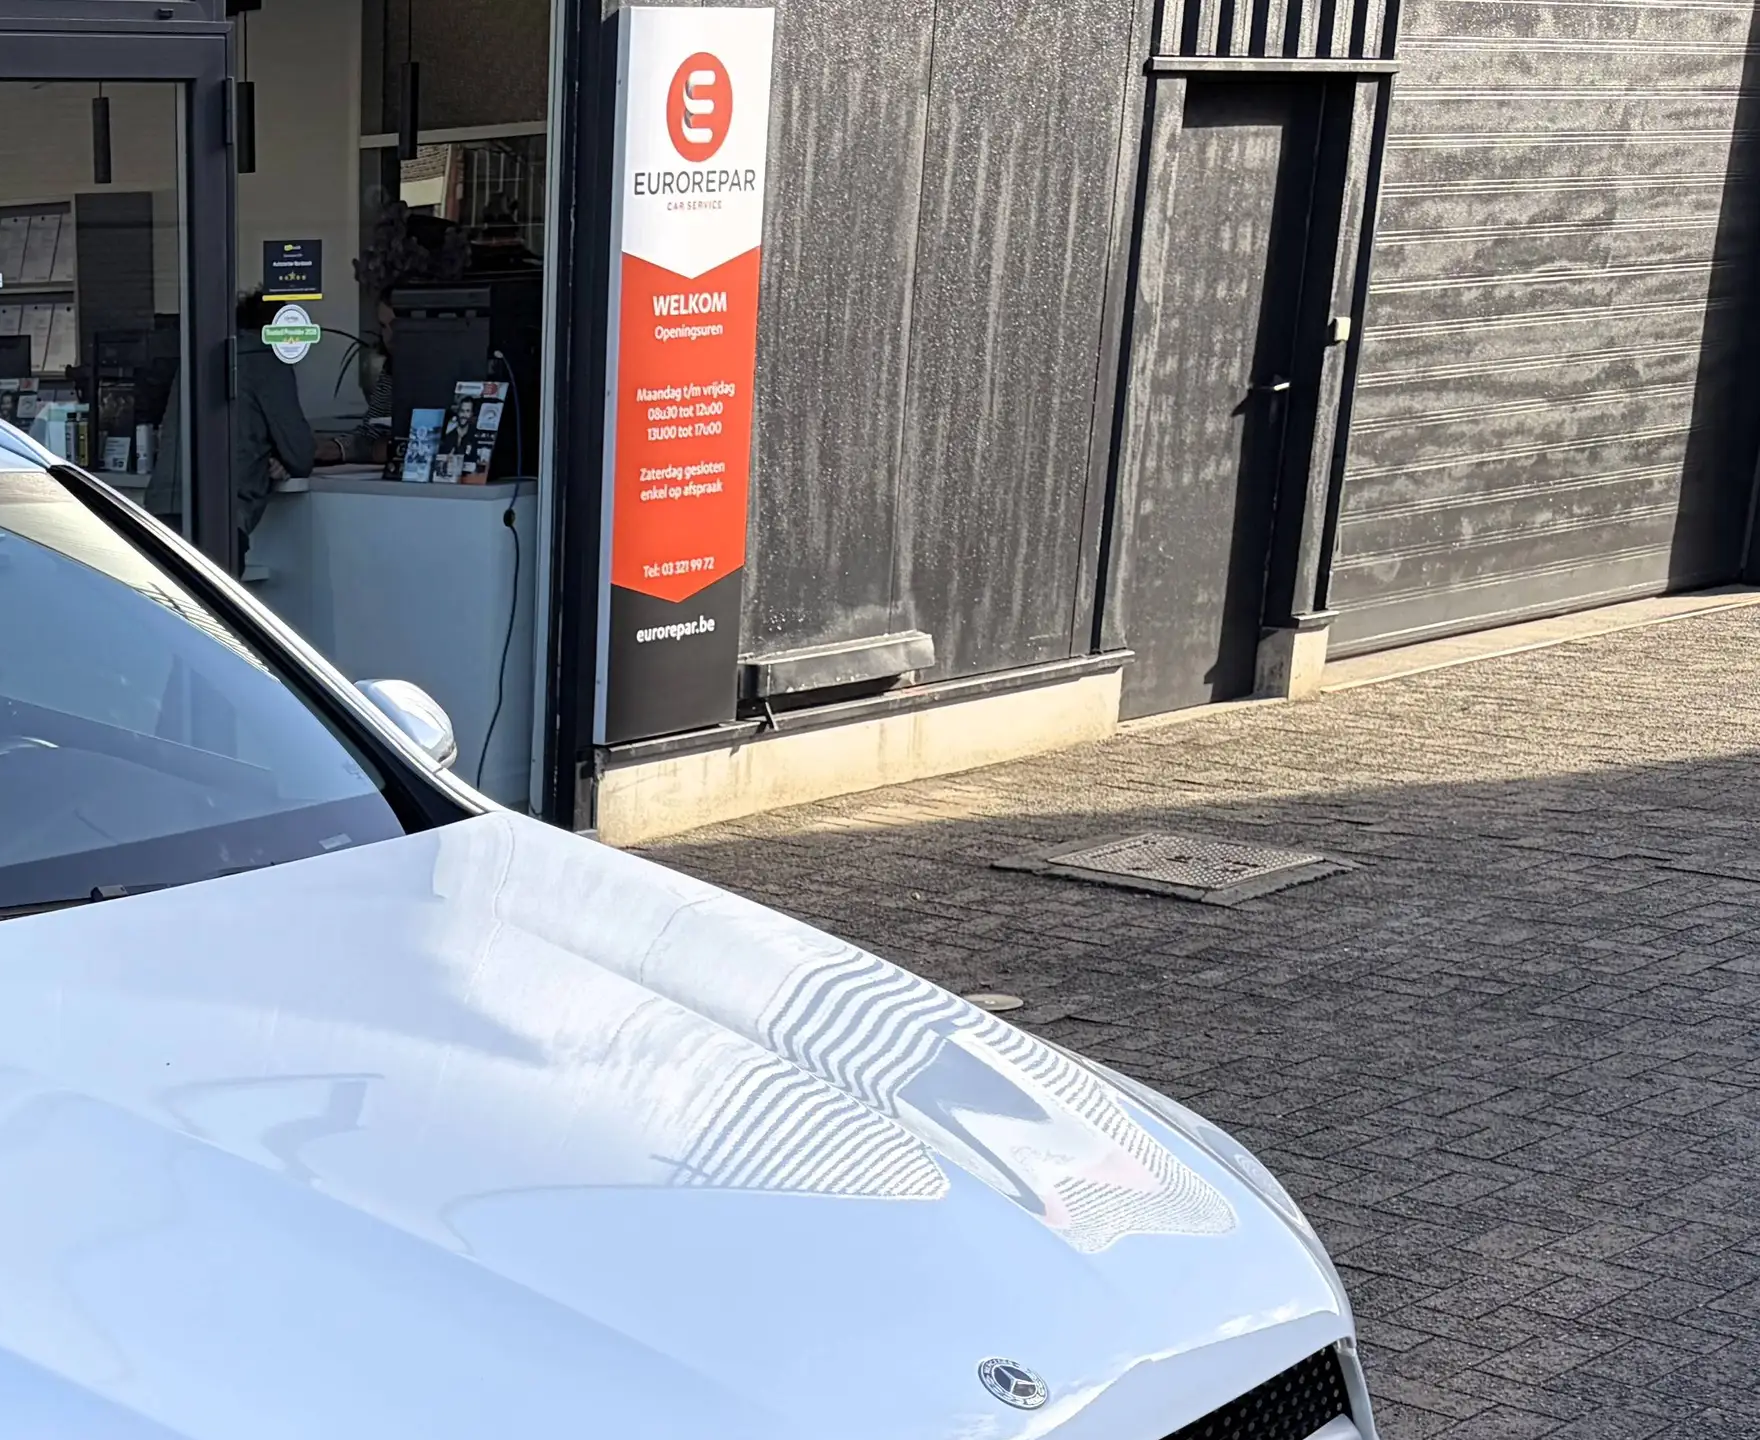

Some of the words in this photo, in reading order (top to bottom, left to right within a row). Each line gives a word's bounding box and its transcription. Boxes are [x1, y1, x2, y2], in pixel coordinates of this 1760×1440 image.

[634, 169, 756, 195] EUROREPAR
[667, 202, 684, 211] CAR
[687, 200, 722, 210] SERVICE
[652, 291, 727, 316] WELKOM
[654, 323, 724, 342] Openingsuren
[636, 384, 682, 402] Maandag
[683, 382, 701, 400] t/m
[702, 380, 735, 398] vrijdag
[647, 405, 678, 421] 08u30
[679, 404, 694, 418] tot
[695, 401, 723, 416] 12u00
[678, 424, 693, 438] tot
[694, 421, 722, 436] 17u00
[640, 463, 683, 481] Zaterdag
[684, 460, 726, 480] gesloten
[640, 484, 668, 501] enkel
[668, 486, 682, 500] op
[683, 478, 723, 498] afspraak
[661, 562, 674, 576] 03
[690, 558, 702, 571] 99
[703, 556, 715, 570] 72
[636, 614, 715, 643] eurorepar.be
